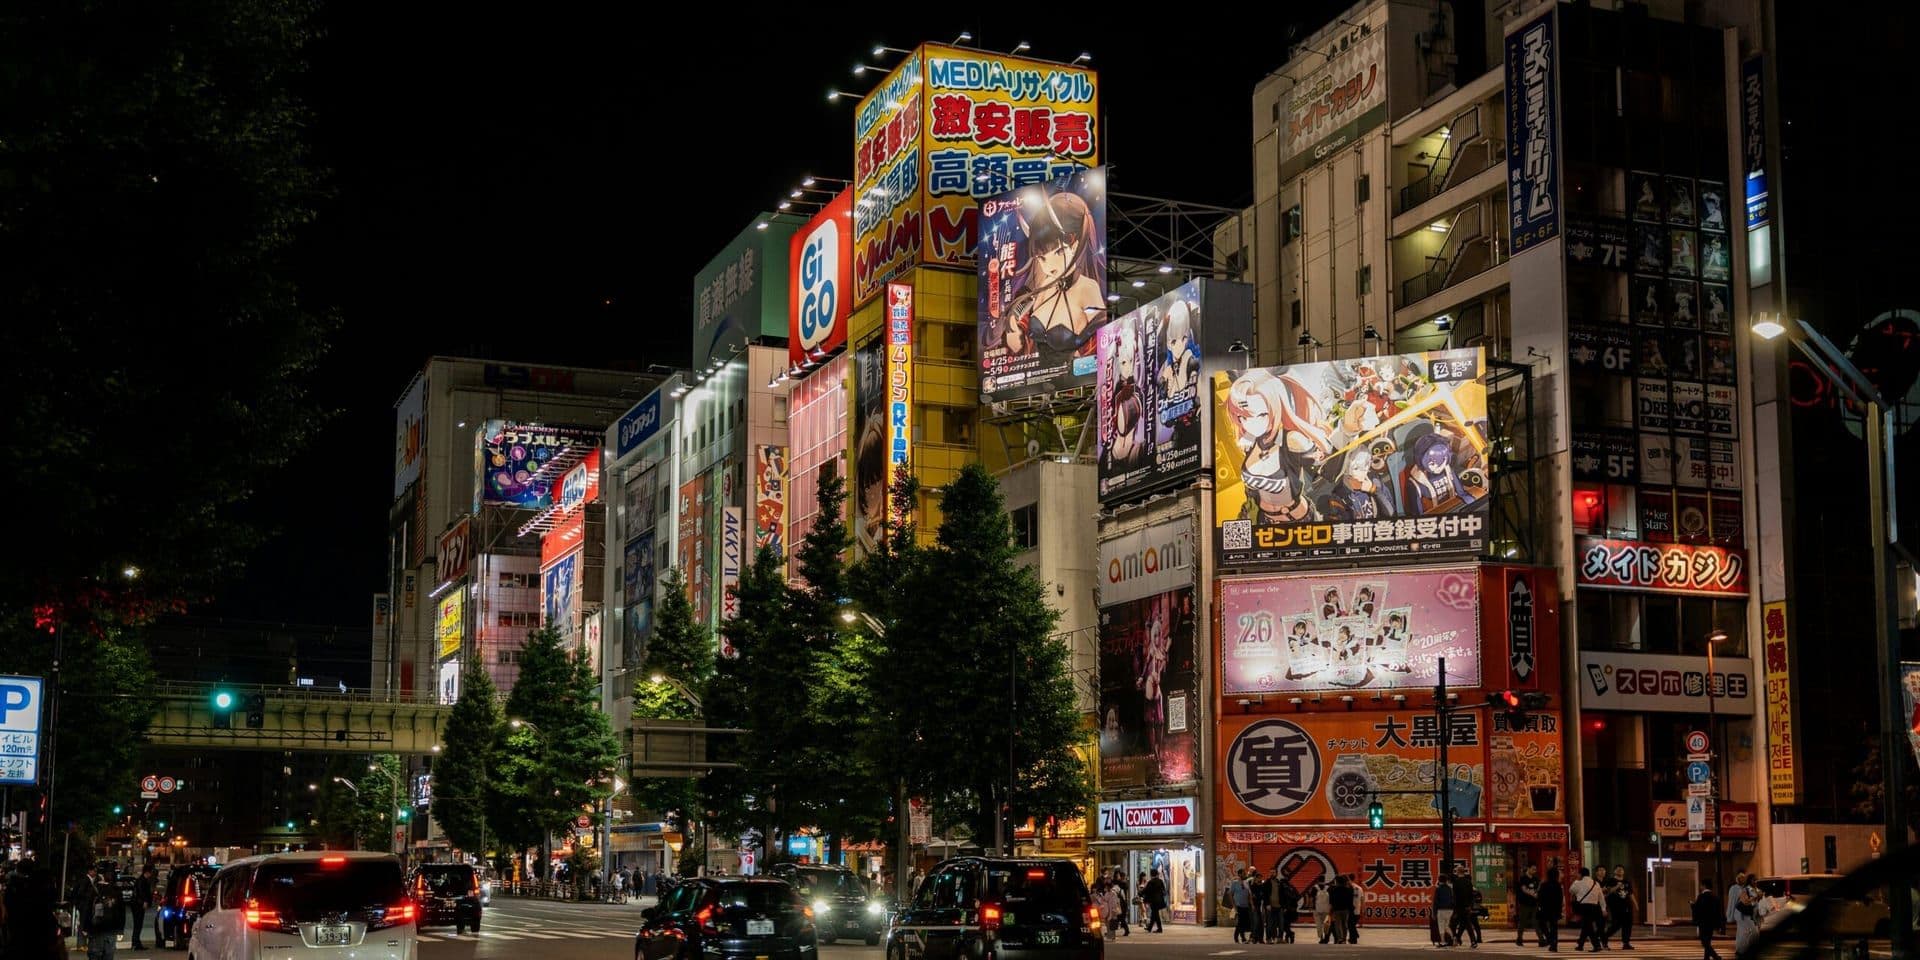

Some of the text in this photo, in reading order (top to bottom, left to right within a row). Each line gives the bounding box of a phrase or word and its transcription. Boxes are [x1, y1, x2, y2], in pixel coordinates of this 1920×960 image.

[930, 58, 1092, 101] MEDIAリサイクル
[1288, 63, 1377, 146] メイドカジノ
[857, 96, 920, 188] 激安販売
[933, 95, 1091, 156] 激安販売
[1000, 241, 1017, 279] 能代
[1600, 244, 1627, 267] 7F
[892, 346, 907, 402] ムーラン
[1603, 347, 1631, 370] 6F
[505, 431, 583, 447] ラブメルシー
[1608, 455, 1634, 478] 5F
[725, 511, 739, 565] AKKY
[1255, 515, 1482, 548] ゼンゼロ事前登録受付中
[1109, 539, 1192, 583] amiami
[1584, 546, 1741, 587] メイドカジノ
[1766, 608, 1786, 673] 免税
[1618, 670, 1747, 697] スマホ修理王
[1779, 678, 1789, 715] TAX
[0, 685, 31, 724] P
[1327, 738, 1370, 751] チケット
[1374, 712, 1480, 748] 大黒屋
[1782, 721, 1792, 769] FREE
[7, 769, 25, 777] 左折
[1238, 735, 1312, 805] 質
[1101, 804, 1174, 832] ZIN COMIC ZIN
